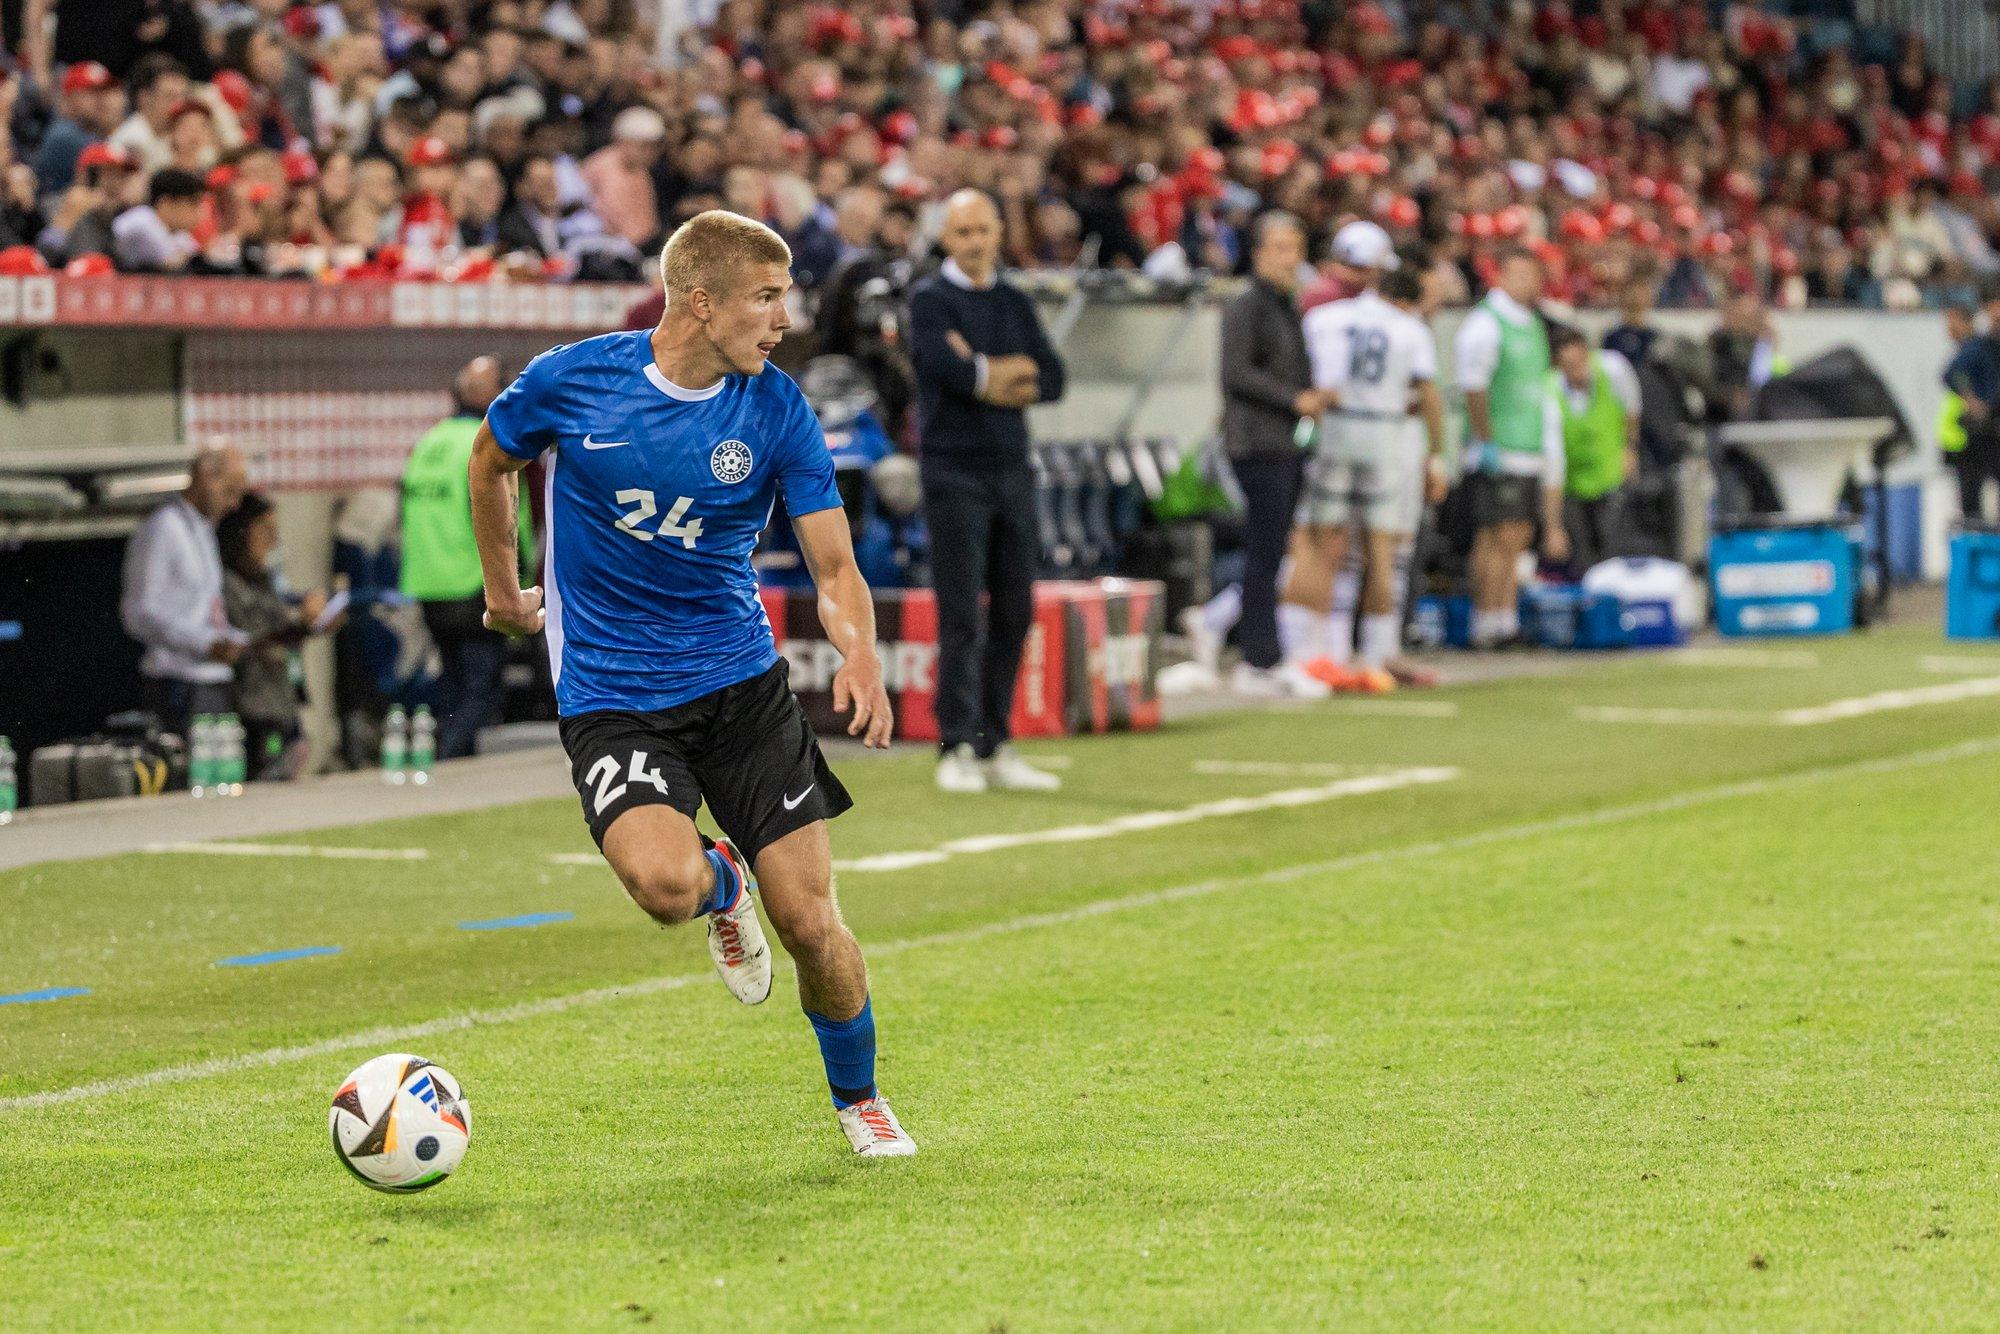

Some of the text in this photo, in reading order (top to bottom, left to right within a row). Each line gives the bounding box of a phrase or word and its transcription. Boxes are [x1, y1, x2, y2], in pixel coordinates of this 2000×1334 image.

[1344, 325, 1389, 385] 18
[713, 453, 751, 481] JALGPALLI LIIT
[721, 442, 745, 452] EESTI
[614, 488, 704, 549] 24
[584, 749, 669, 817] 24
